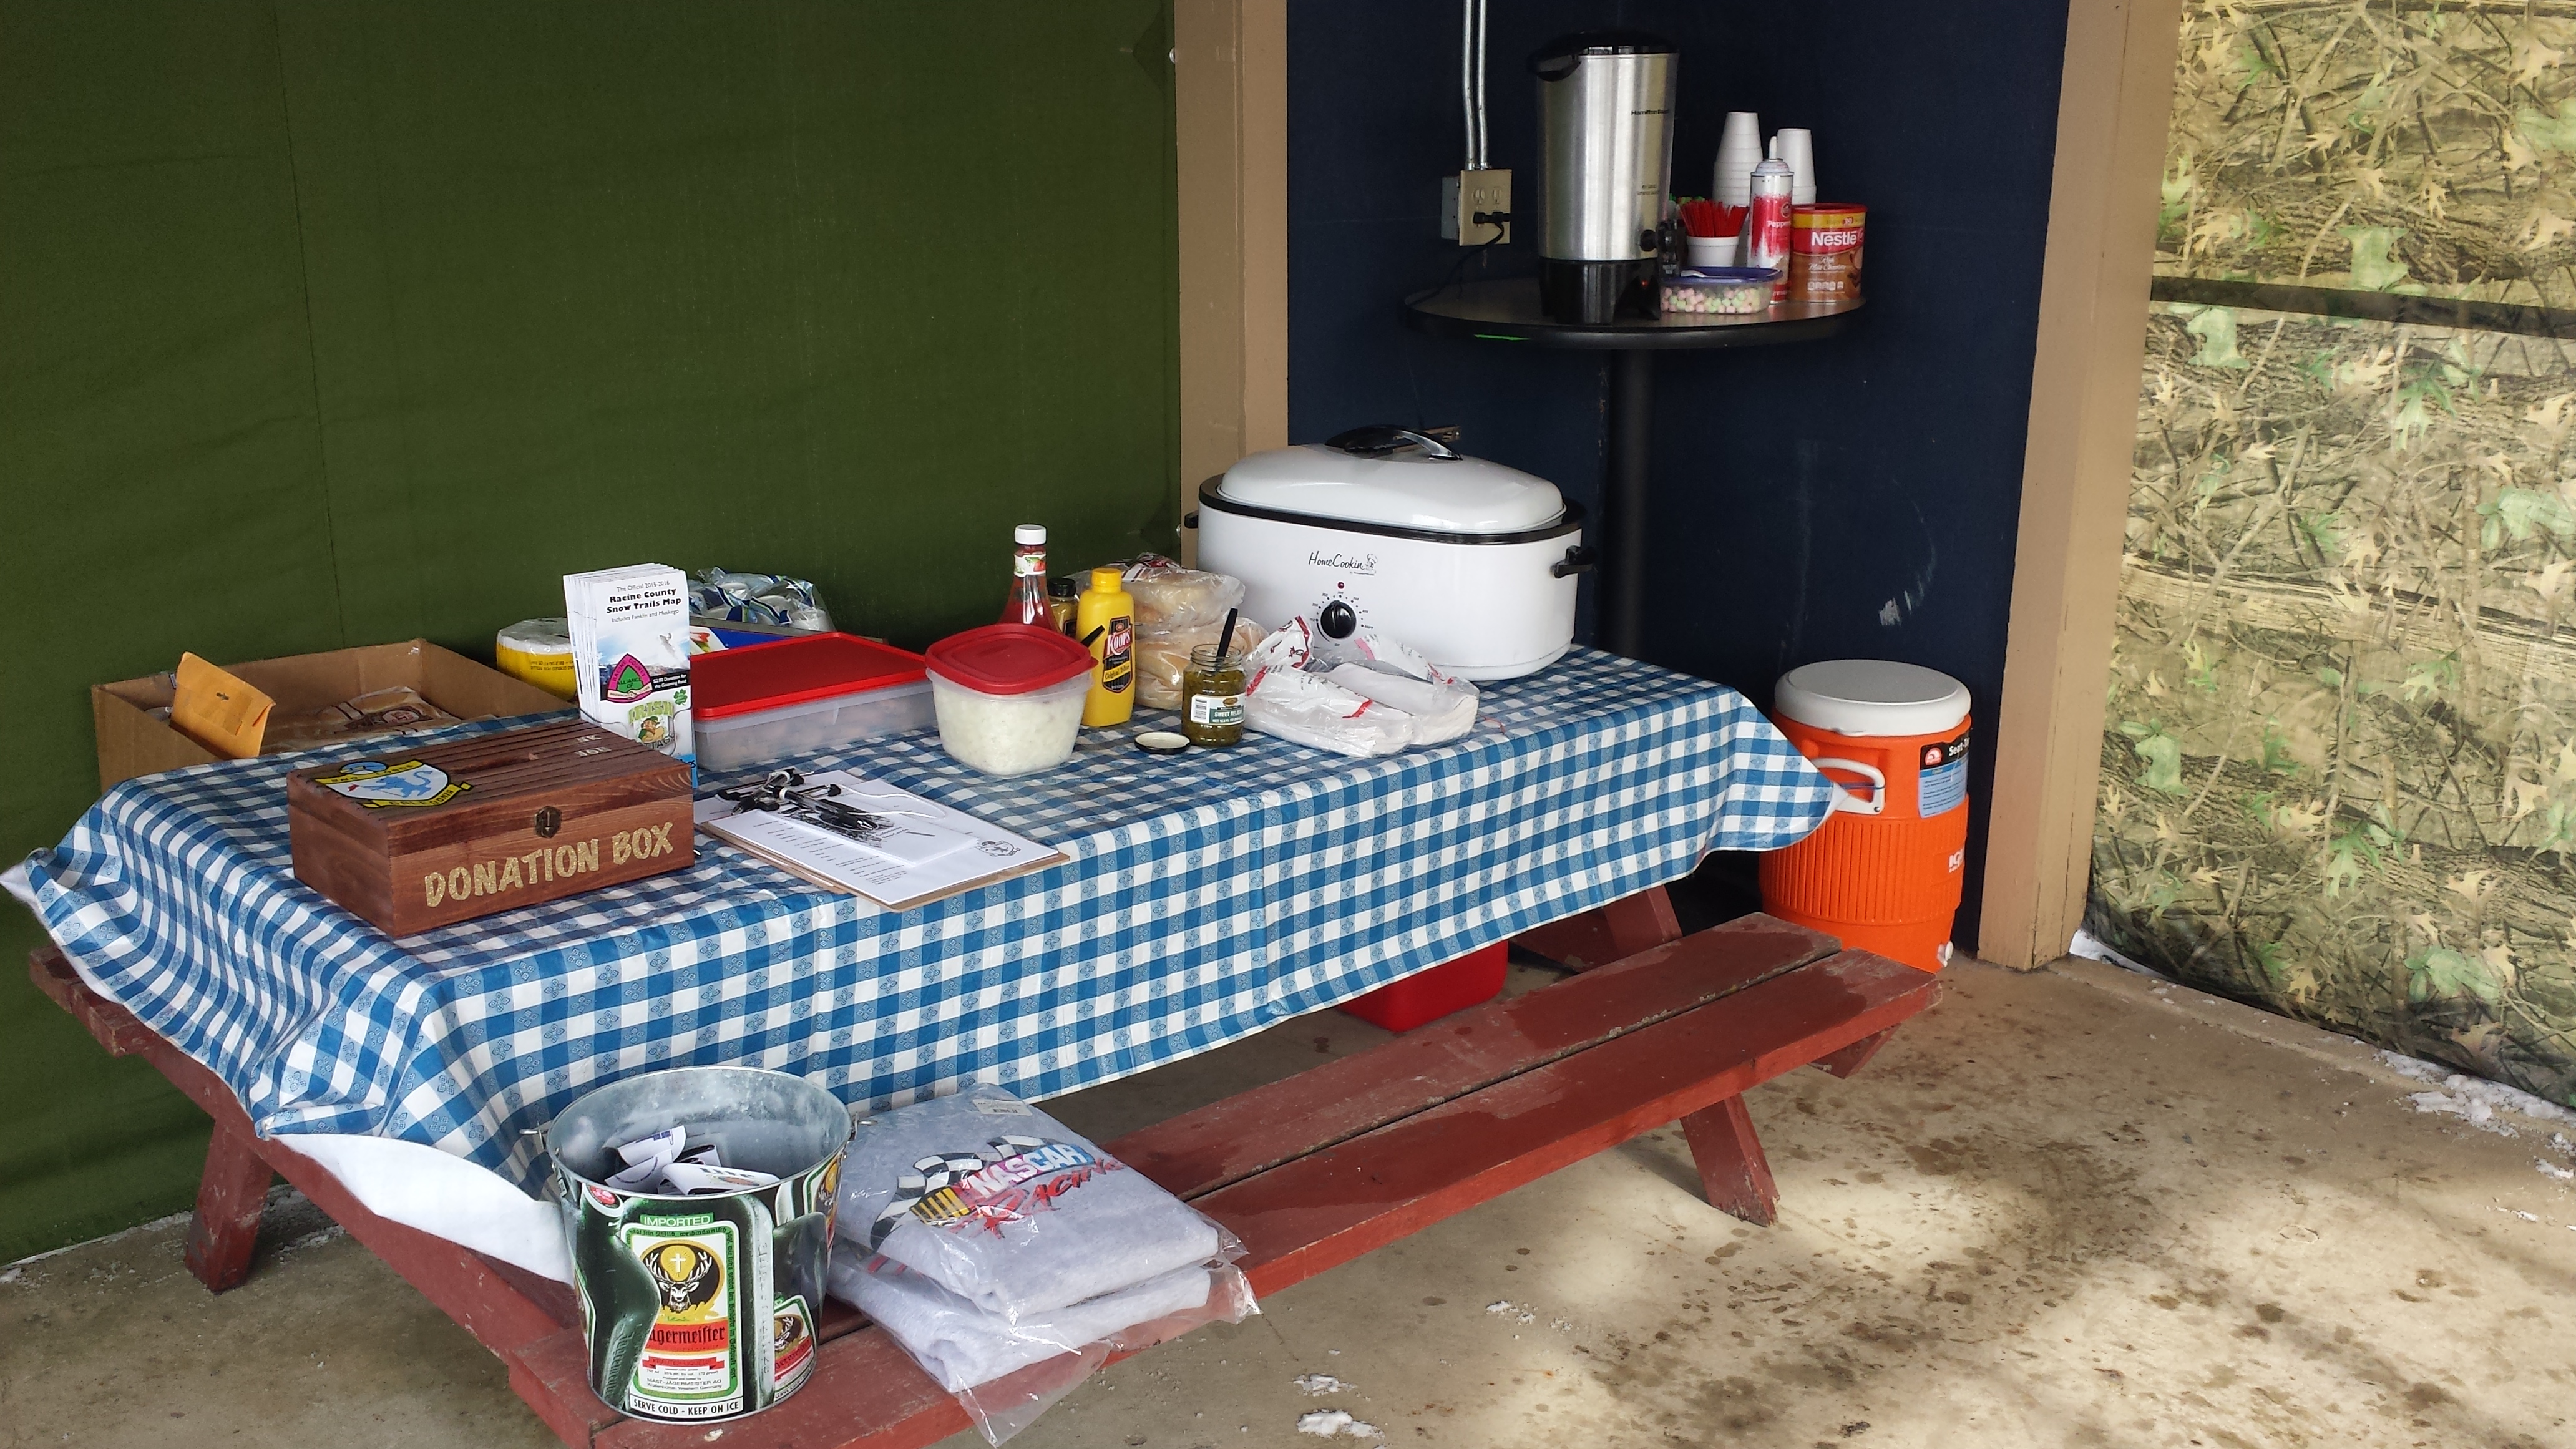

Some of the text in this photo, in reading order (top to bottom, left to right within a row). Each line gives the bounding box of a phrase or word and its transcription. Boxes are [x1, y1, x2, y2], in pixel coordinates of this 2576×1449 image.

[645, 580, 670, 588] 2015-2016
[609, 588, 676, 603] Racine County
[606, 598, 681, 613] Snow Trails Map
[628, 700, 674, 724] IRISH
[388, 789, 454, 806] CALEDONIA
[424, 821, 674, 908] DONATION BOX
[964, 1143, 1087, 1198] NASCAR
[643, 1216, 711, 1227] IMPORTED
[634, 1398, 655, 1412] SERVE
[658, 1405, 678, 1415] COLD
[688, 1407, 708, 1415] KEEP
[711, 1404, 723, 1414] ON
[726, 1401, 739, 1412] ICE
